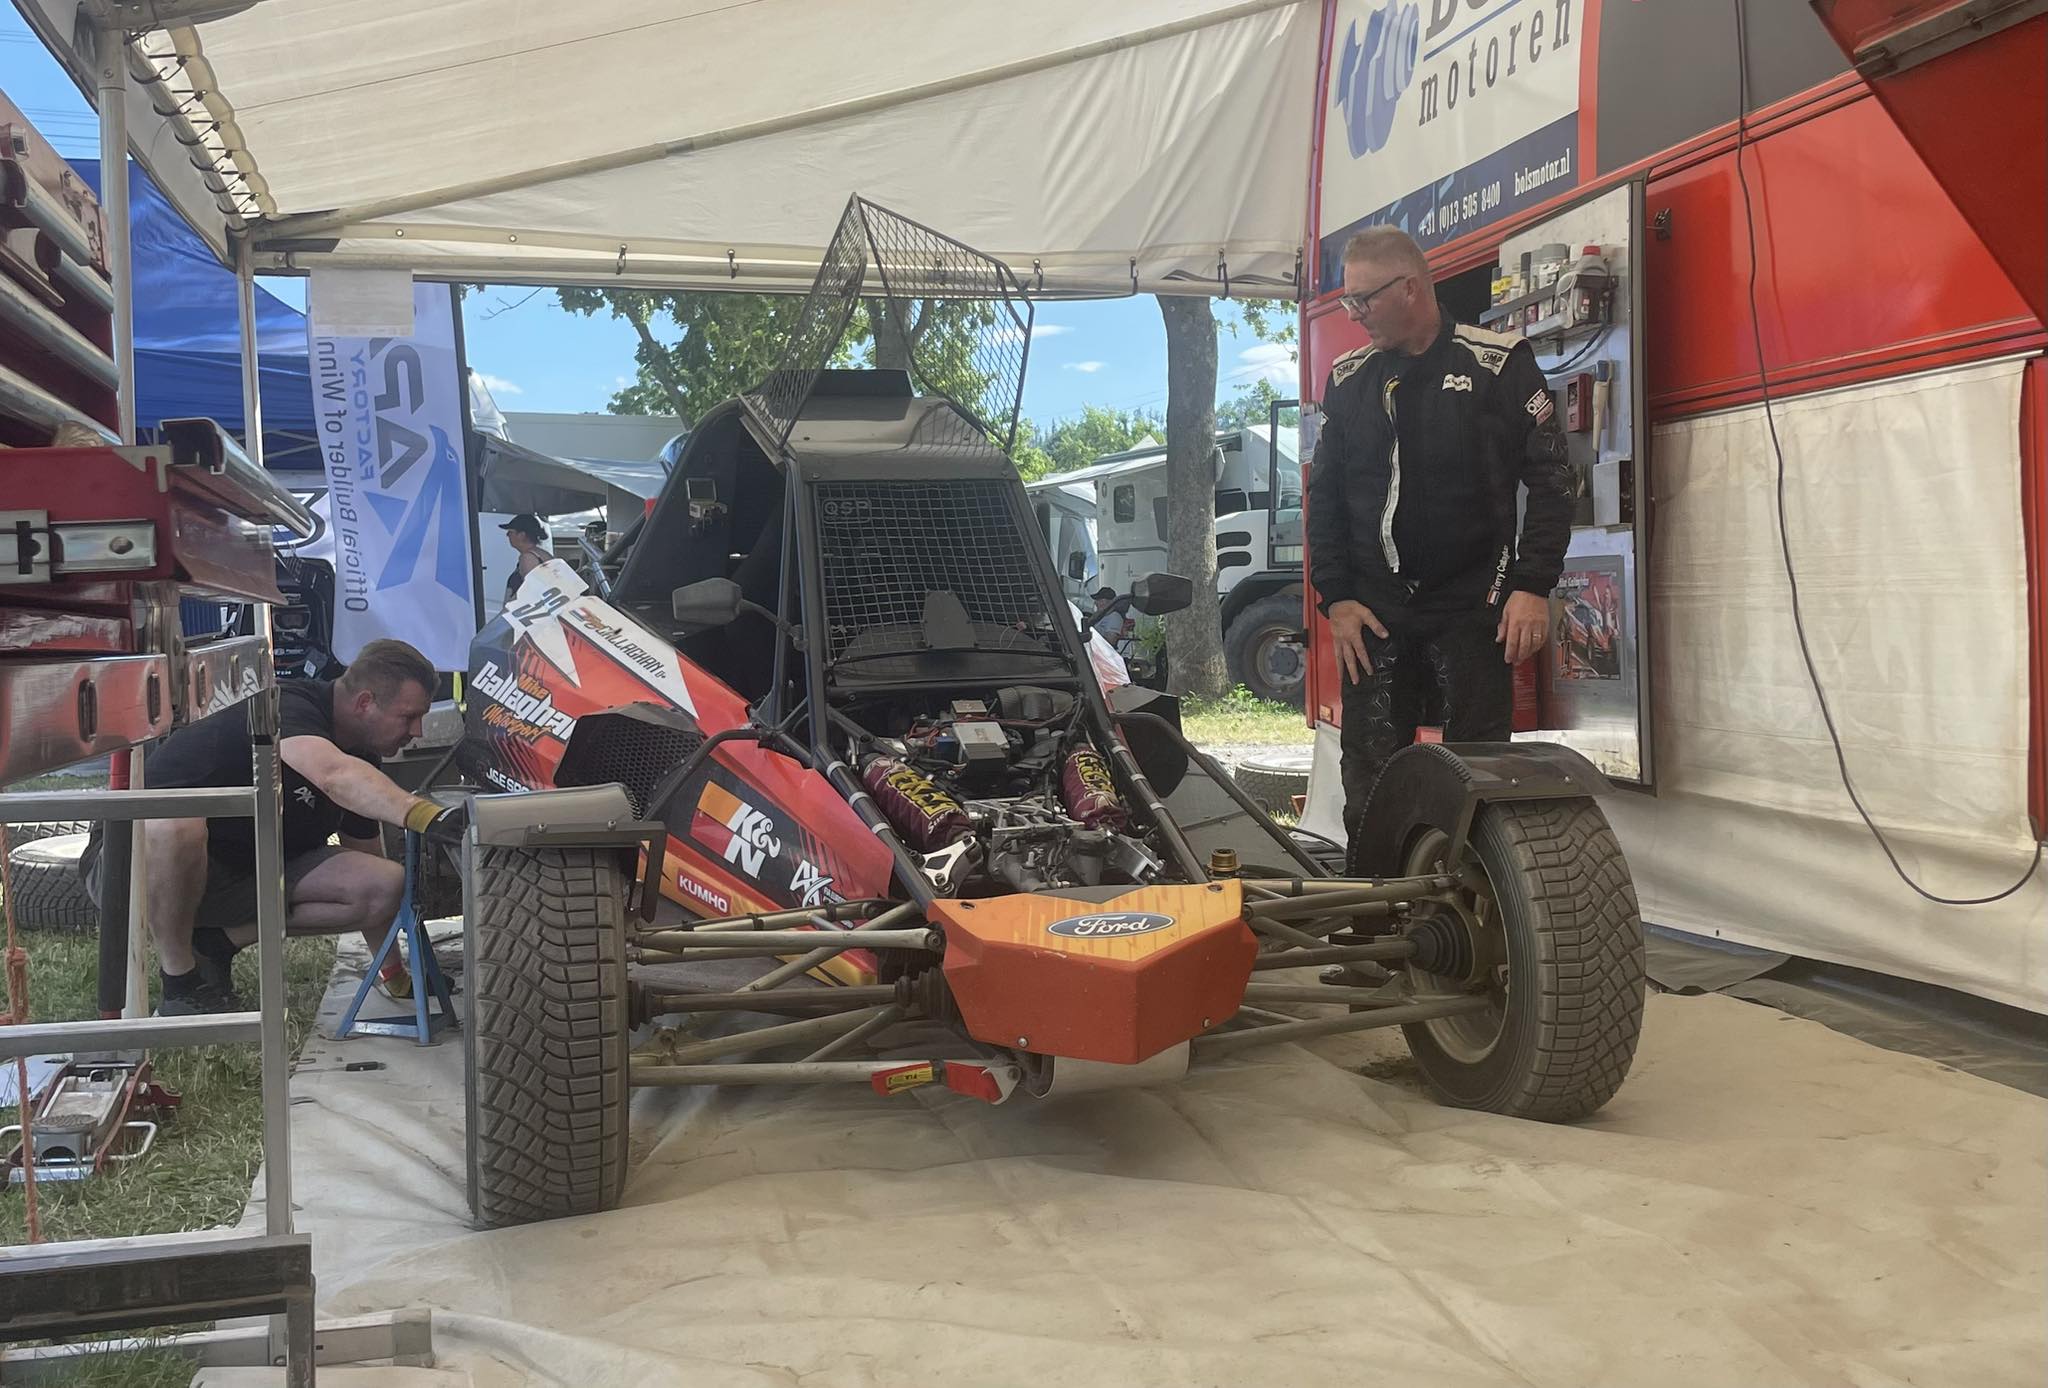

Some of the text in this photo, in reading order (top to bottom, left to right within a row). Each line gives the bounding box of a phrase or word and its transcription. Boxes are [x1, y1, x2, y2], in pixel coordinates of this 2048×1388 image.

[1419, 0, 1571, 127] motoren
[1514, 147, 1571, 197] bolsmotor.nl
[1439, 201, 1459, 234] (0)13
[1462, 192, 1478, 220] 505
[1481, 181, 1501, 212] 8400
[1482, 352, 1504, 364] OMP
[1526, 391, 1547, 414] OMP
[824, 501, 869, 517] QSP
[511, 586, 571, 628] 32
[599, 625, 665, 674] CALLAGHAN
[723, 801, 781, 879] K&N
[679, 874, 728, 914] KUMHO
[1074, 915, 1151, 936] Ford
